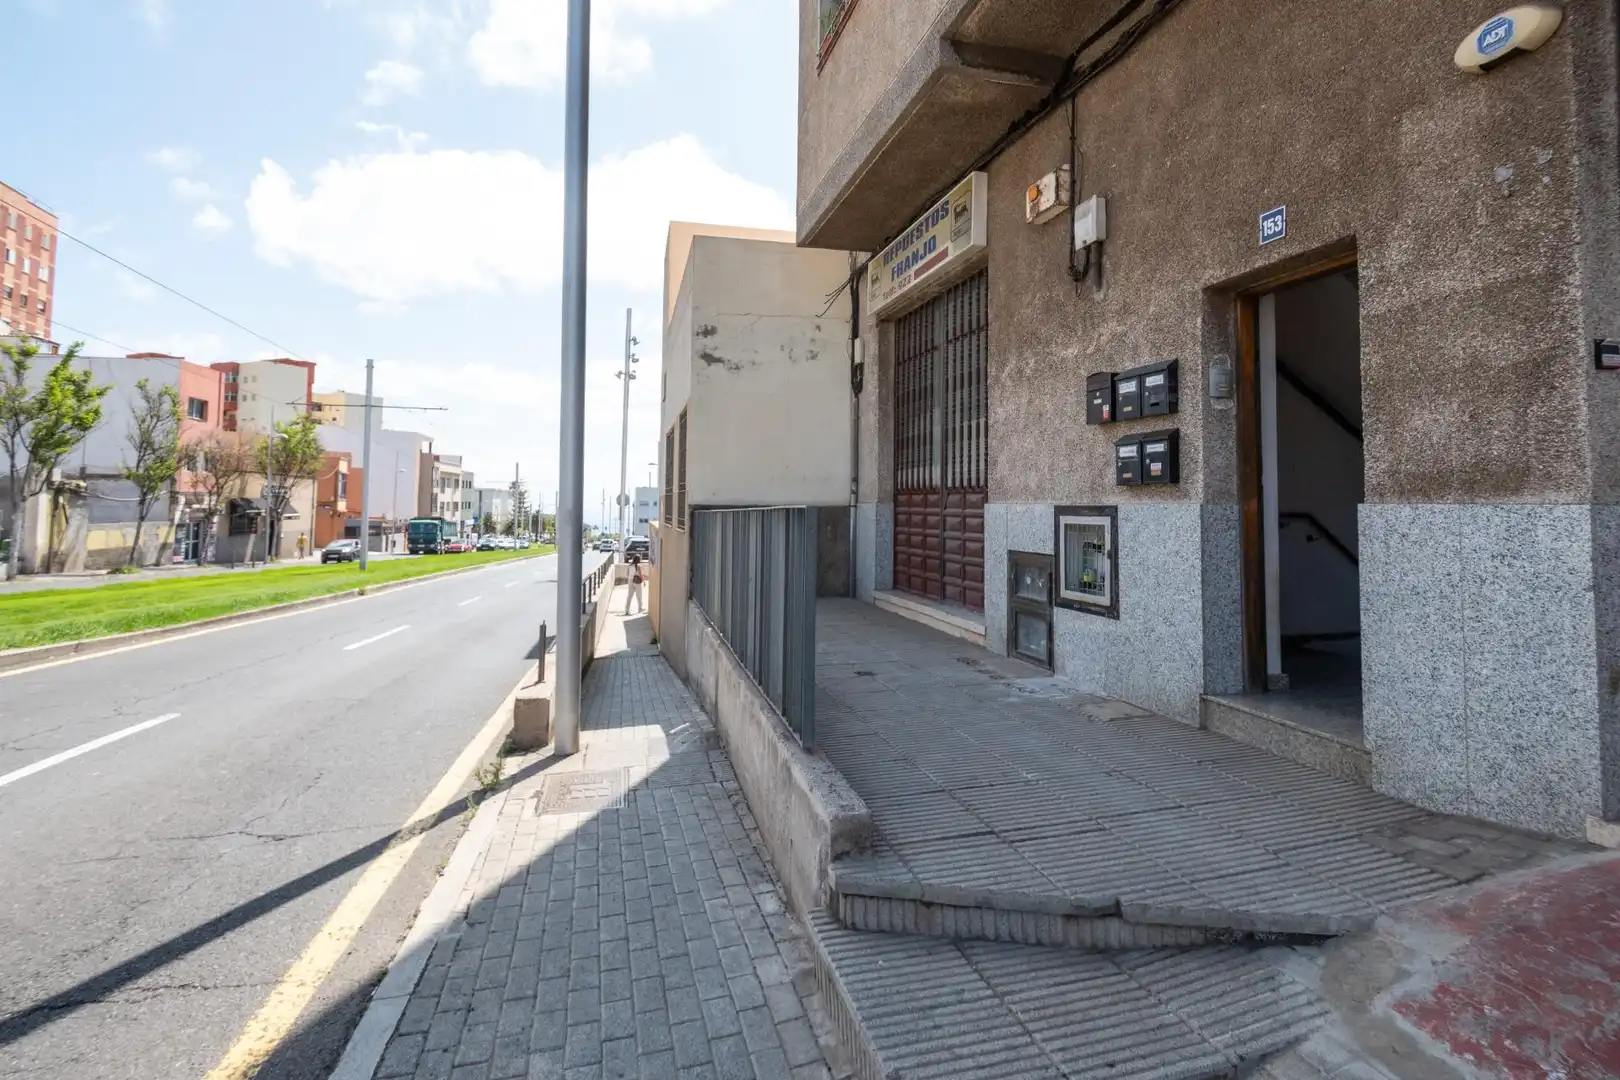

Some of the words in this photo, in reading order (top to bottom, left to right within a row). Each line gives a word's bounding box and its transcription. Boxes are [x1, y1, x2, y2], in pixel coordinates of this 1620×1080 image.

[1482, 23, 1509, 47] ADT
[883, 199, 950, 267] REPUESTOS
[1262, 214, 1283, 237] 153
[891, 234, 937, 282] FRANJO
